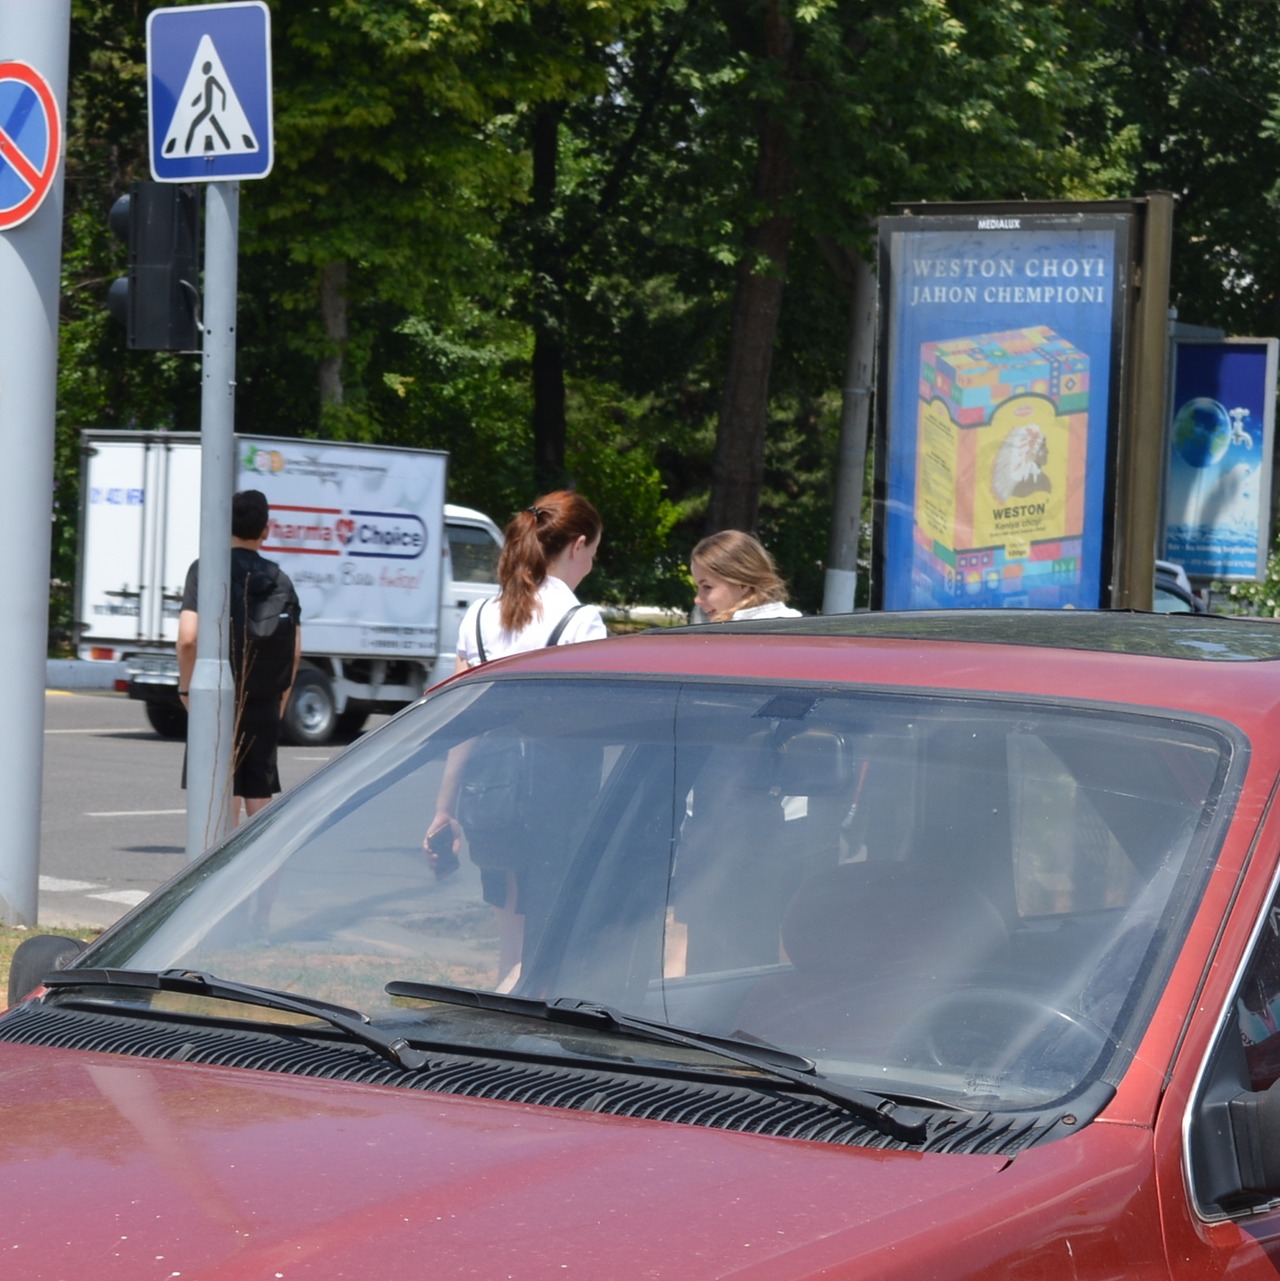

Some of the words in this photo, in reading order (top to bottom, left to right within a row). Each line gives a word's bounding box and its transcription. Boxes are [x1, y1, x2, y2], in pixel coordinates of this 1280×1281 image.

[978, 219, 1021, 229] MEDIALUX
[913, 259, 1015, 278] WESTON
[1024, 258, 1106, 277] CHOYI
[911, 286, 977, 306] JAHON
[983, 286, 1105, 303] CHEMPIONI
[993, 503, 1045, 521] WESTON
[359, 524, 424, 548] Choice
